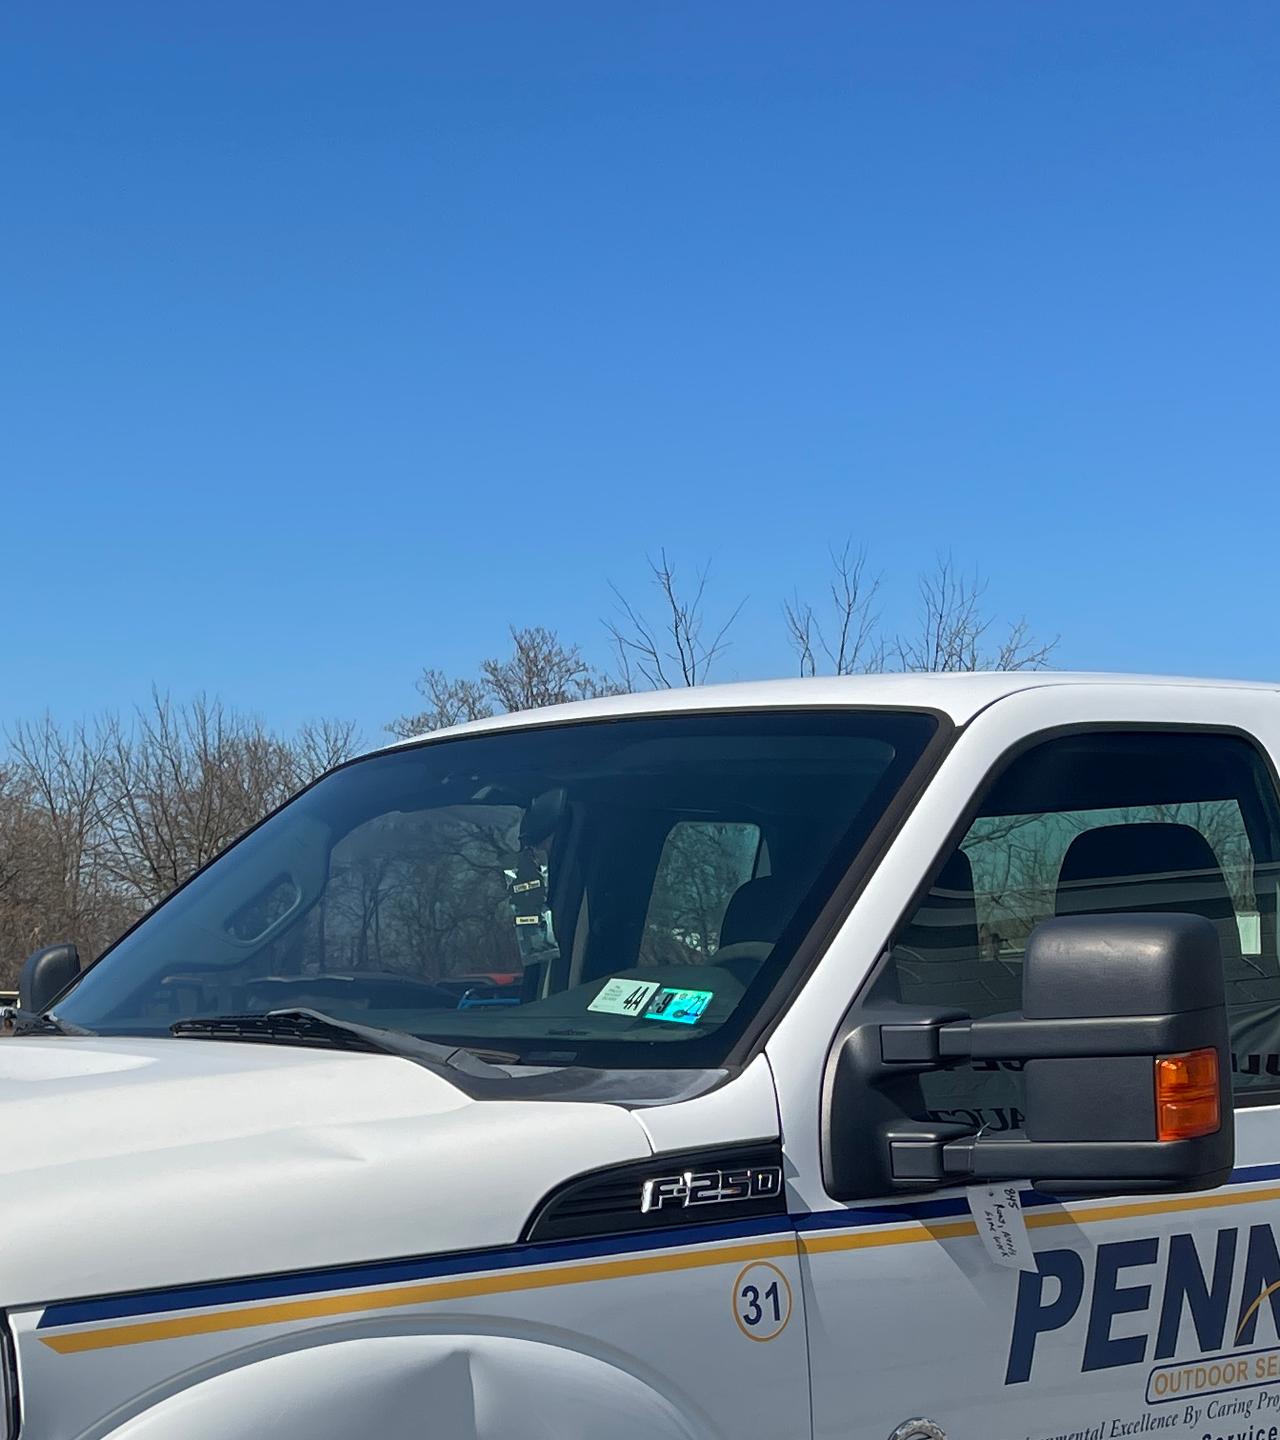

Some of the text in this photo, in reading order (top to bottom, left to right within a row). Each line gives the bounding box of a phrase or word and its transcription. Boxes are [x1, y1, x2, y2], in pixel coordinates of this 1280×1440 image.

[623, 986, 650, 1011] 4A
[640, 1166, 783, 1214] F-250
[741, 1281, 781, 1326] 31
[1154, 1360, 1249, 1396] OUTDOOR
[1109, 1412, 1178, 1439] Excellence
[1183, 1405, 1202, 1429] By
[1207, 1399, 1254, 1419] Caring
